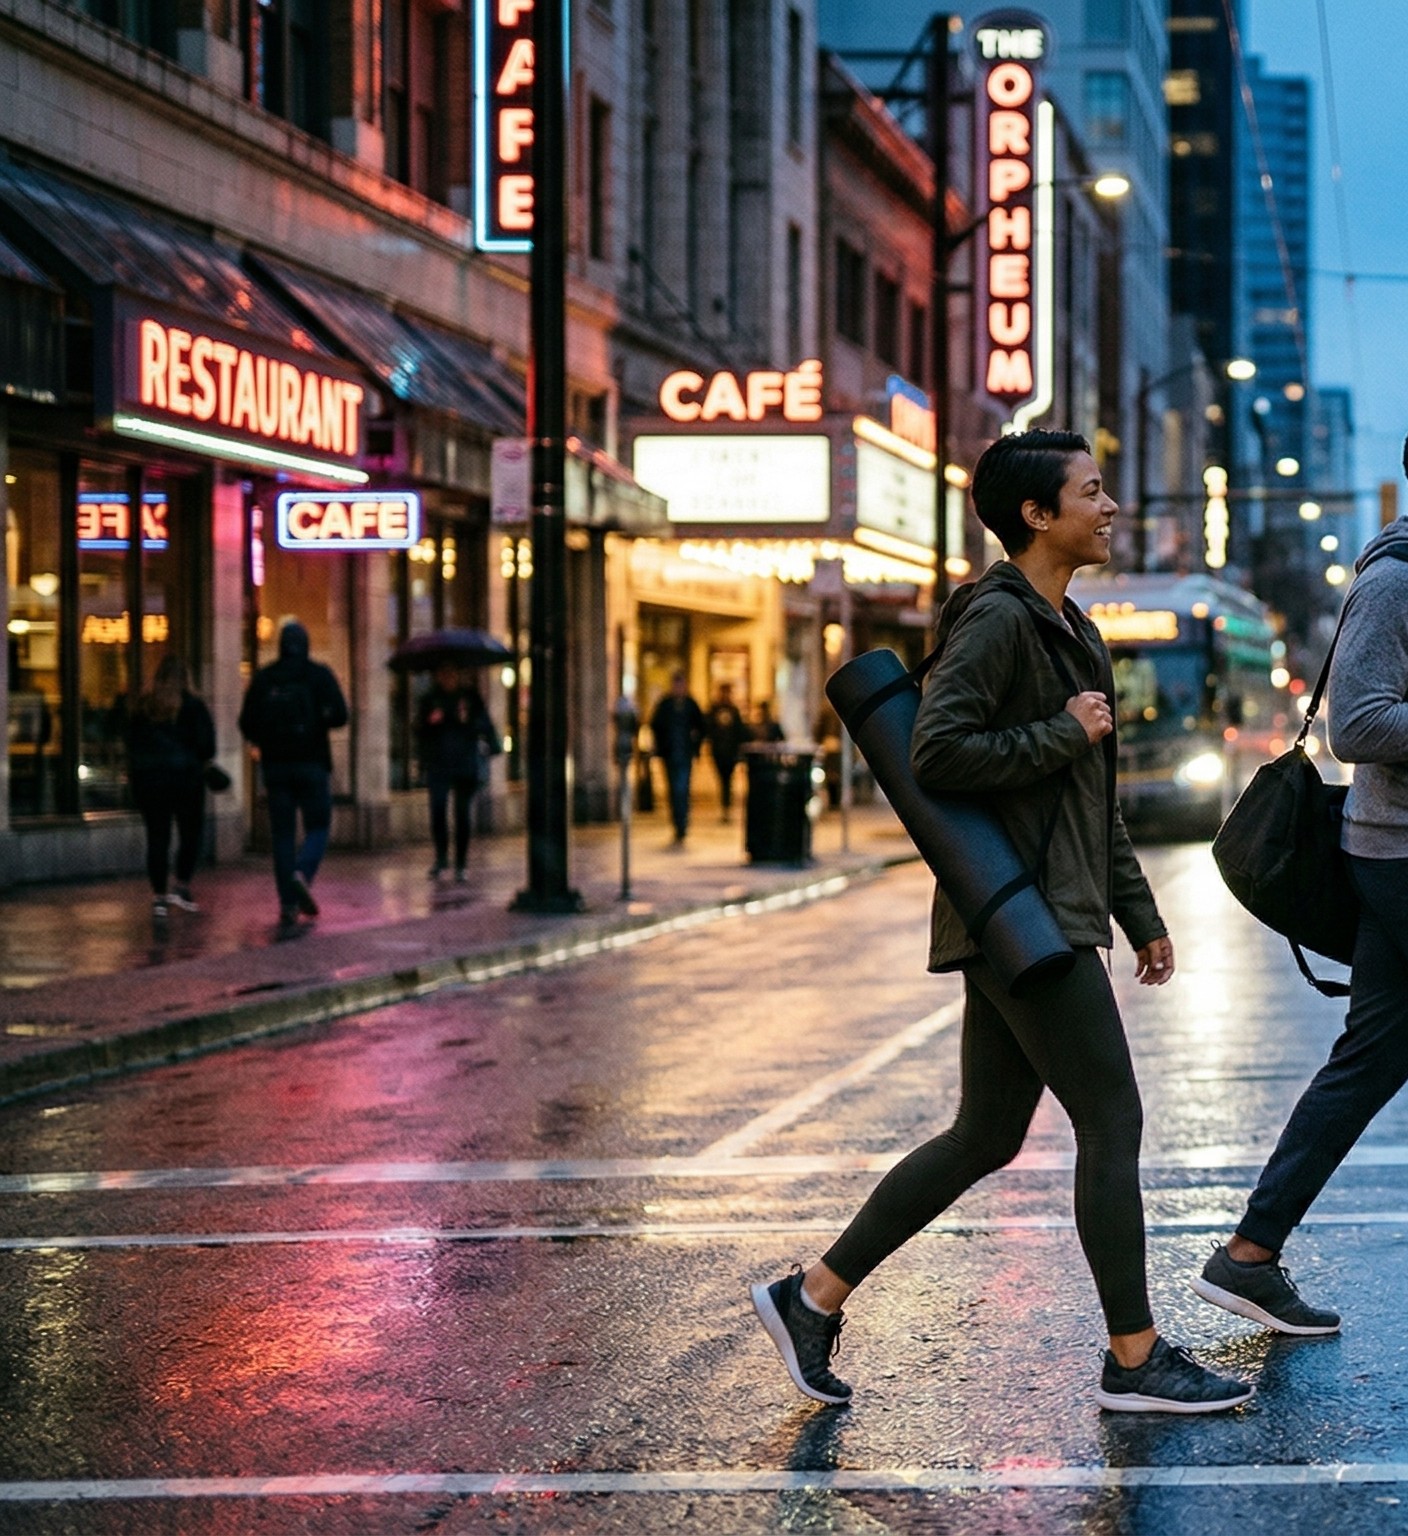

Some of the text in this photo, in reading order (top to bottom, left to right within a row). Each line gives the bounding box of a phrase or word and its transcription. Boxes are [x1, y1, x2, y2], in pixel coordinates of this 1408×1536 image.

[977, 29, 1044, 58] THE
[986, 62, 1033, 393] ORPHEUM
[140, 318, 364, 456] RESTAURANT
[659, 358, 823, 422] CAFÉ
[287, 501, 408, 540] CAFE
